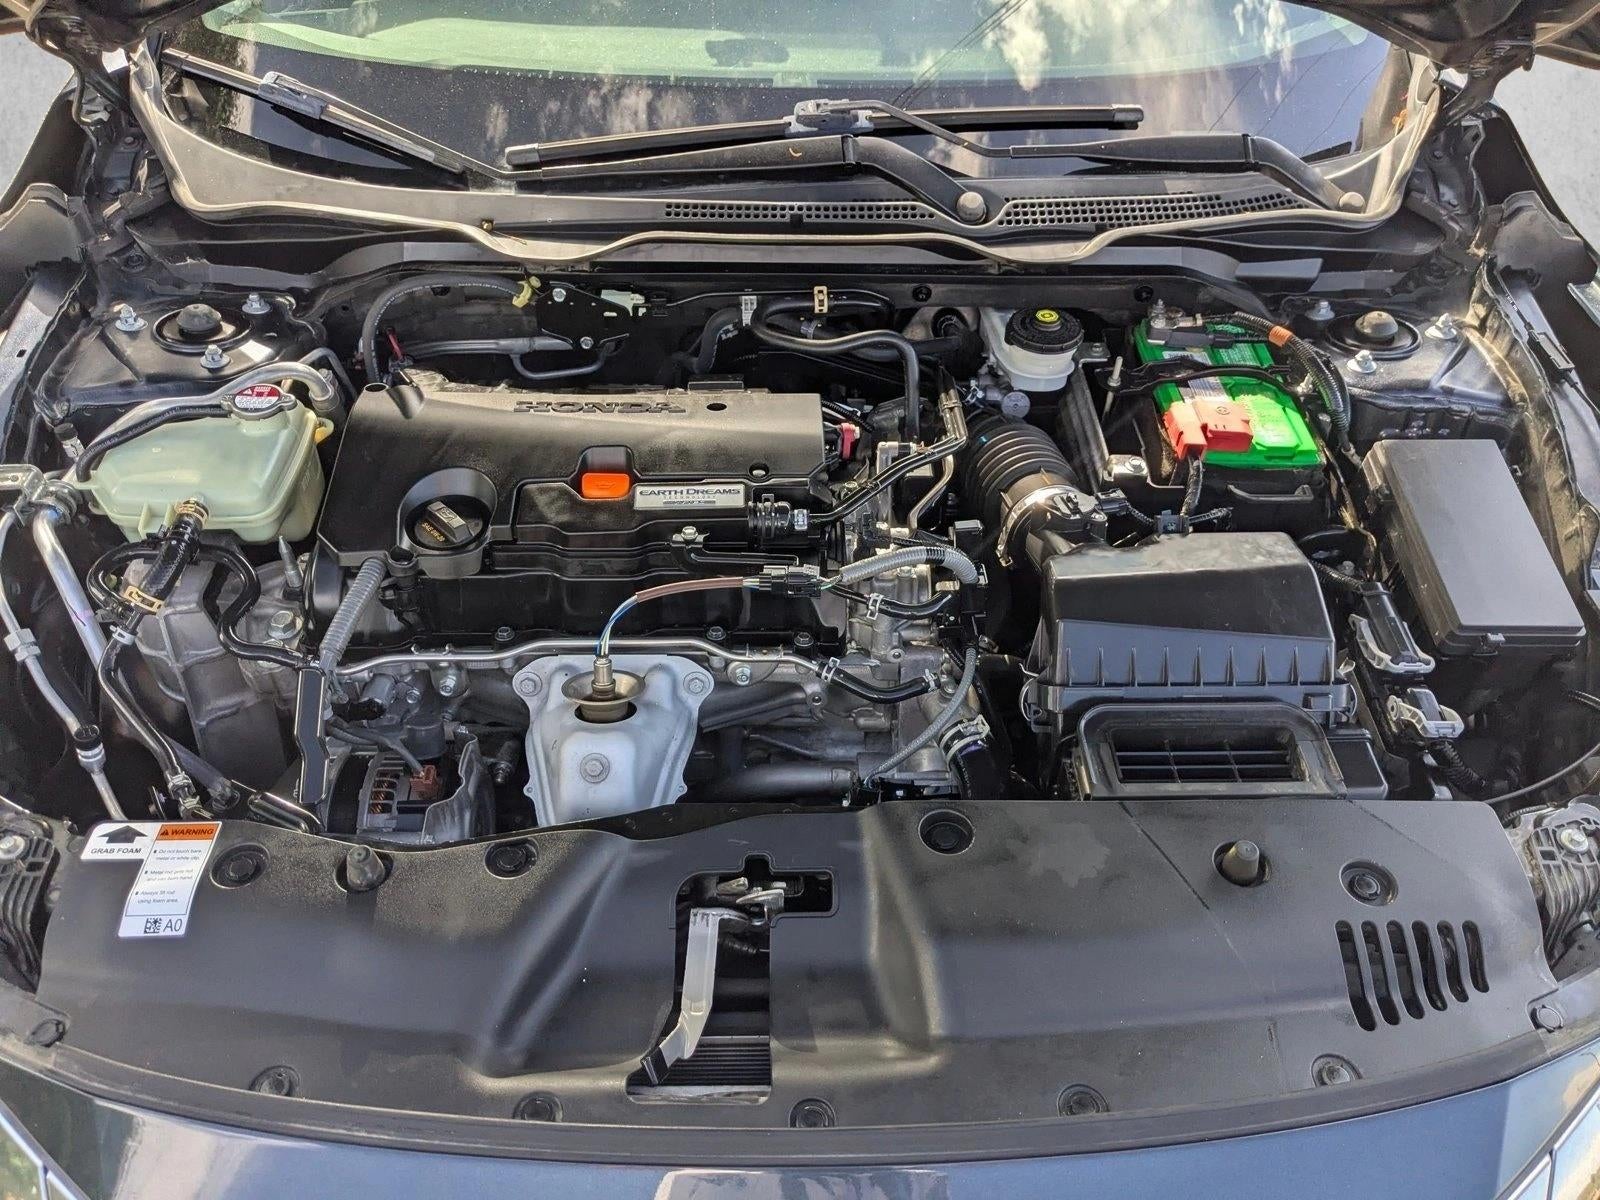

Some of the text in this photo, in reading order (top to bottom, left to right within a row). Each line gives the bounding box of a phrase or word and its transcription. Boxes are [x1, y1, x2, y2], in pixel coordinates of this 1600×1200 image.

[513, 400, 687, 414] HONDA
[686, 488, 741, 496] DREAMS
[170, 828, 214, 836] WARNING
[162, 918, 183, 933] A0
